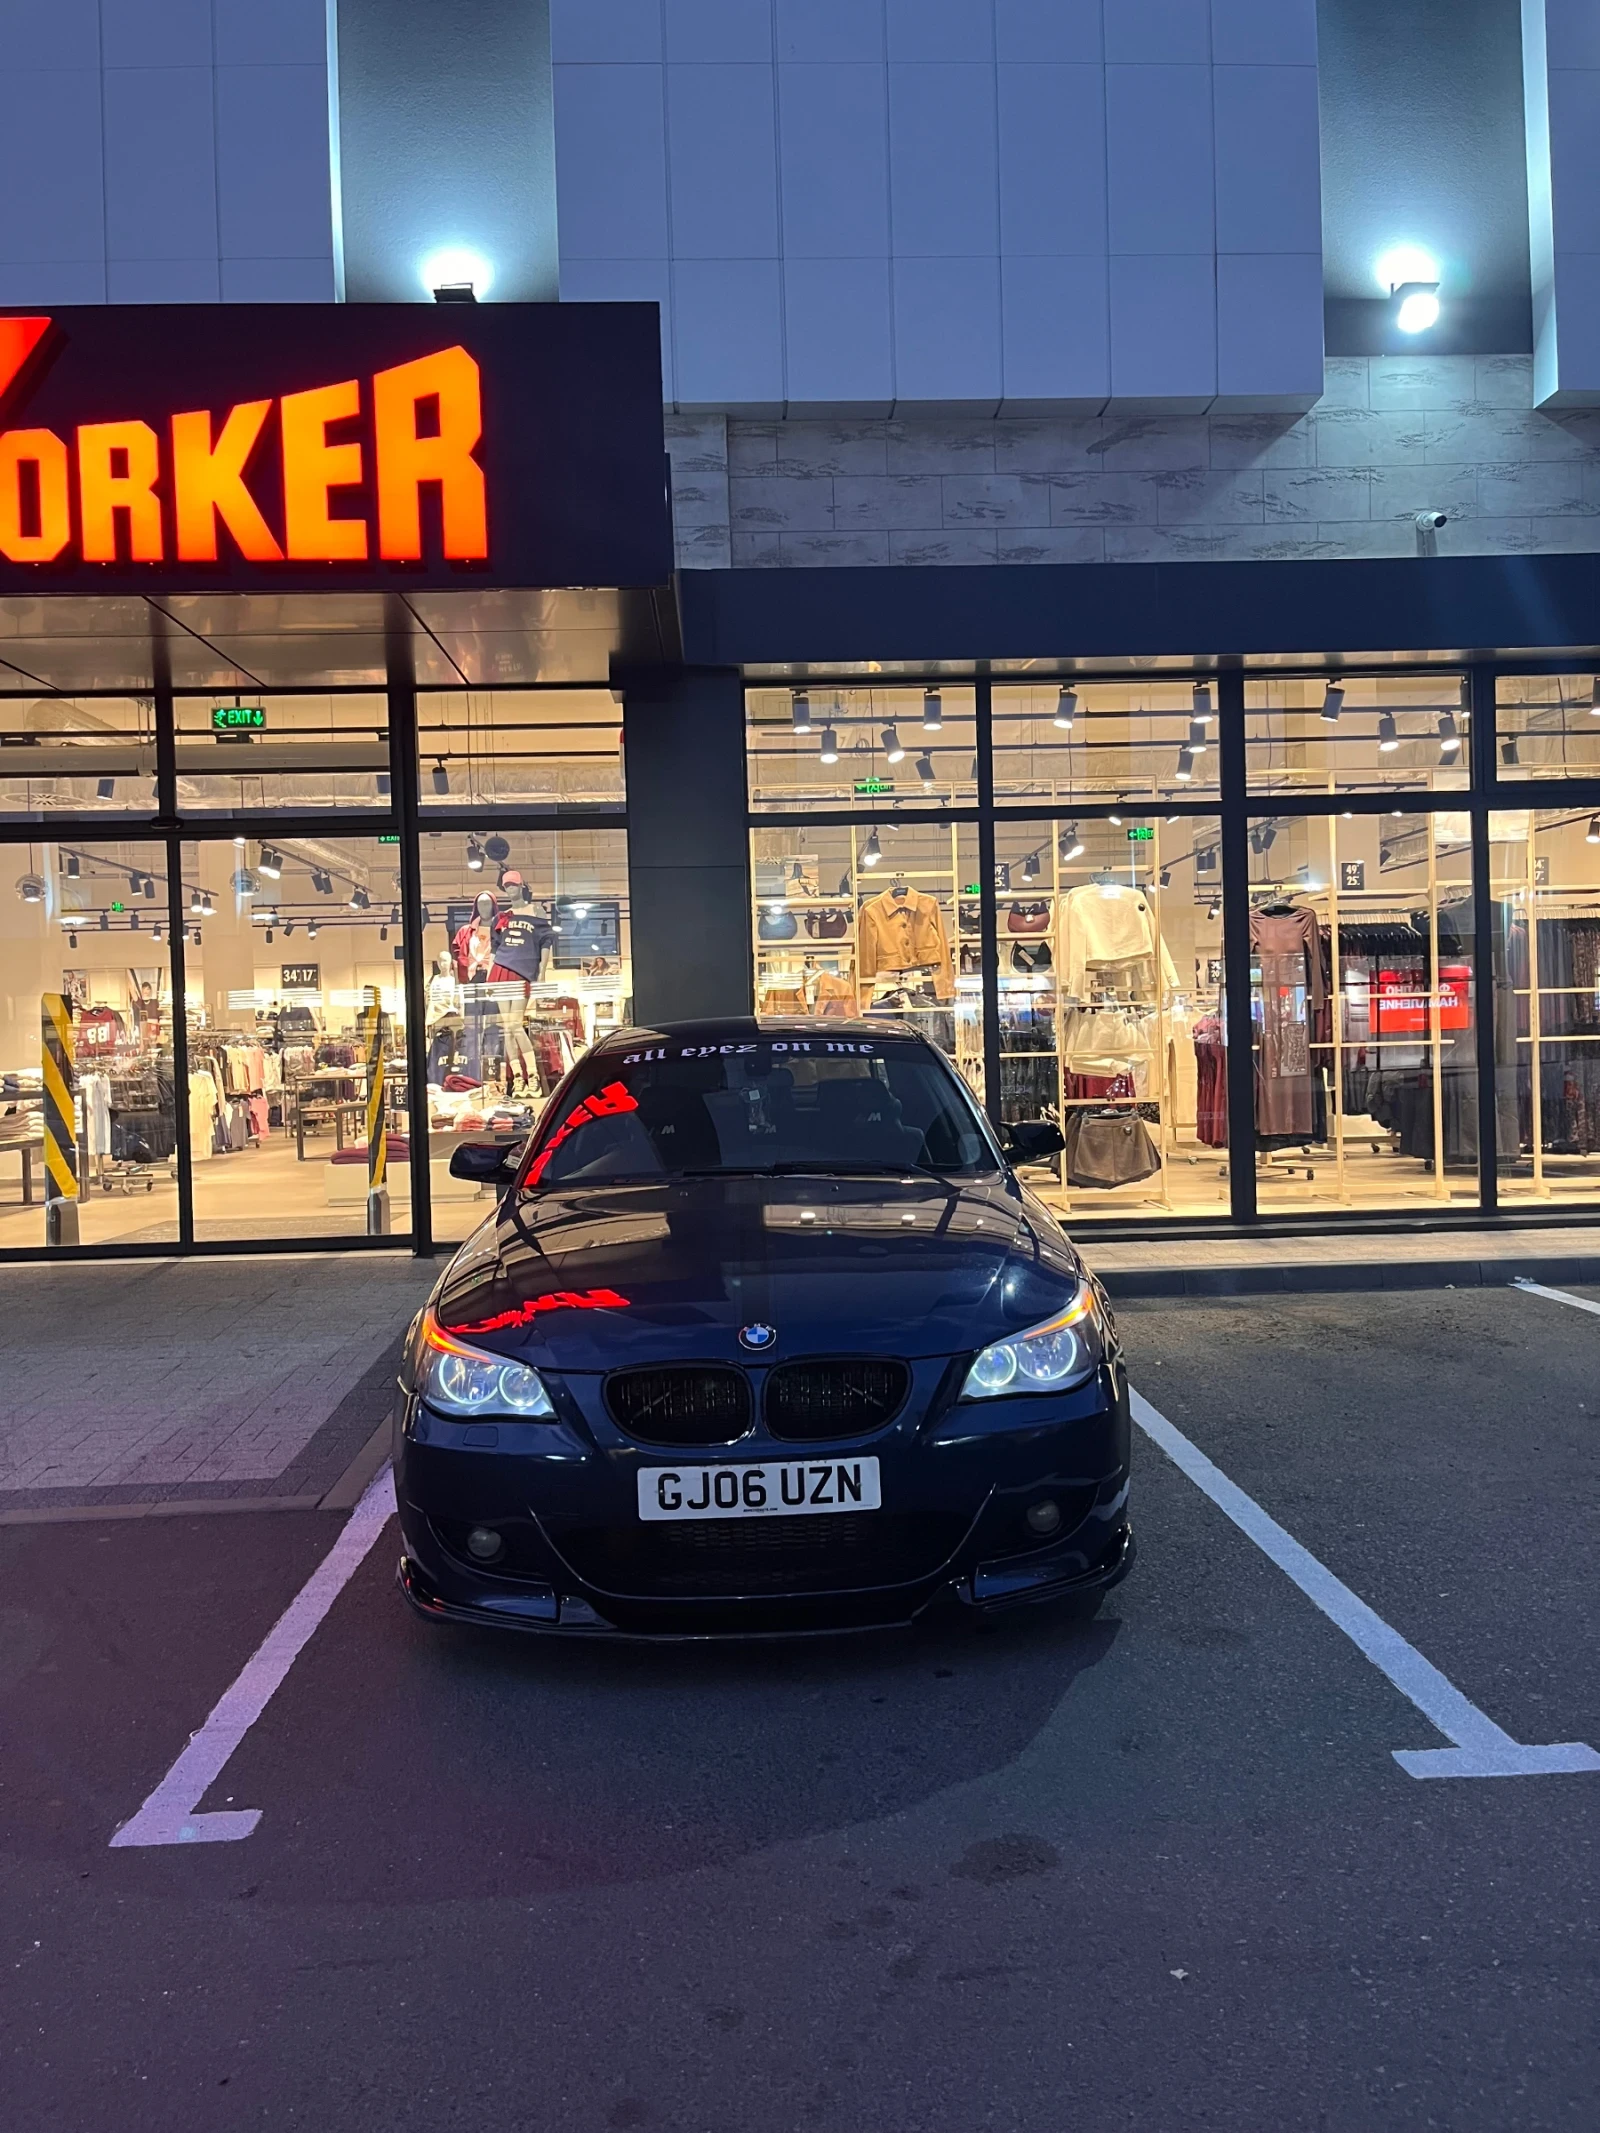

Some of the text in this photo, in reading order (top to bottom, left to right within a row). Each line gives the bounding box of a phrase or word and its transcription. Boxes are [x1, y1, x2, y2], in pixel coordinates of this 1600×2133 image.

[0, 316, 488, 562] ORKER
[227, 709, 252, 724] EXIT
[501, 920, 535, 934] HLETIC
[623, 1041, 875, 1065] all eyez on me
[780, 1463, 862, 1506] UZN
